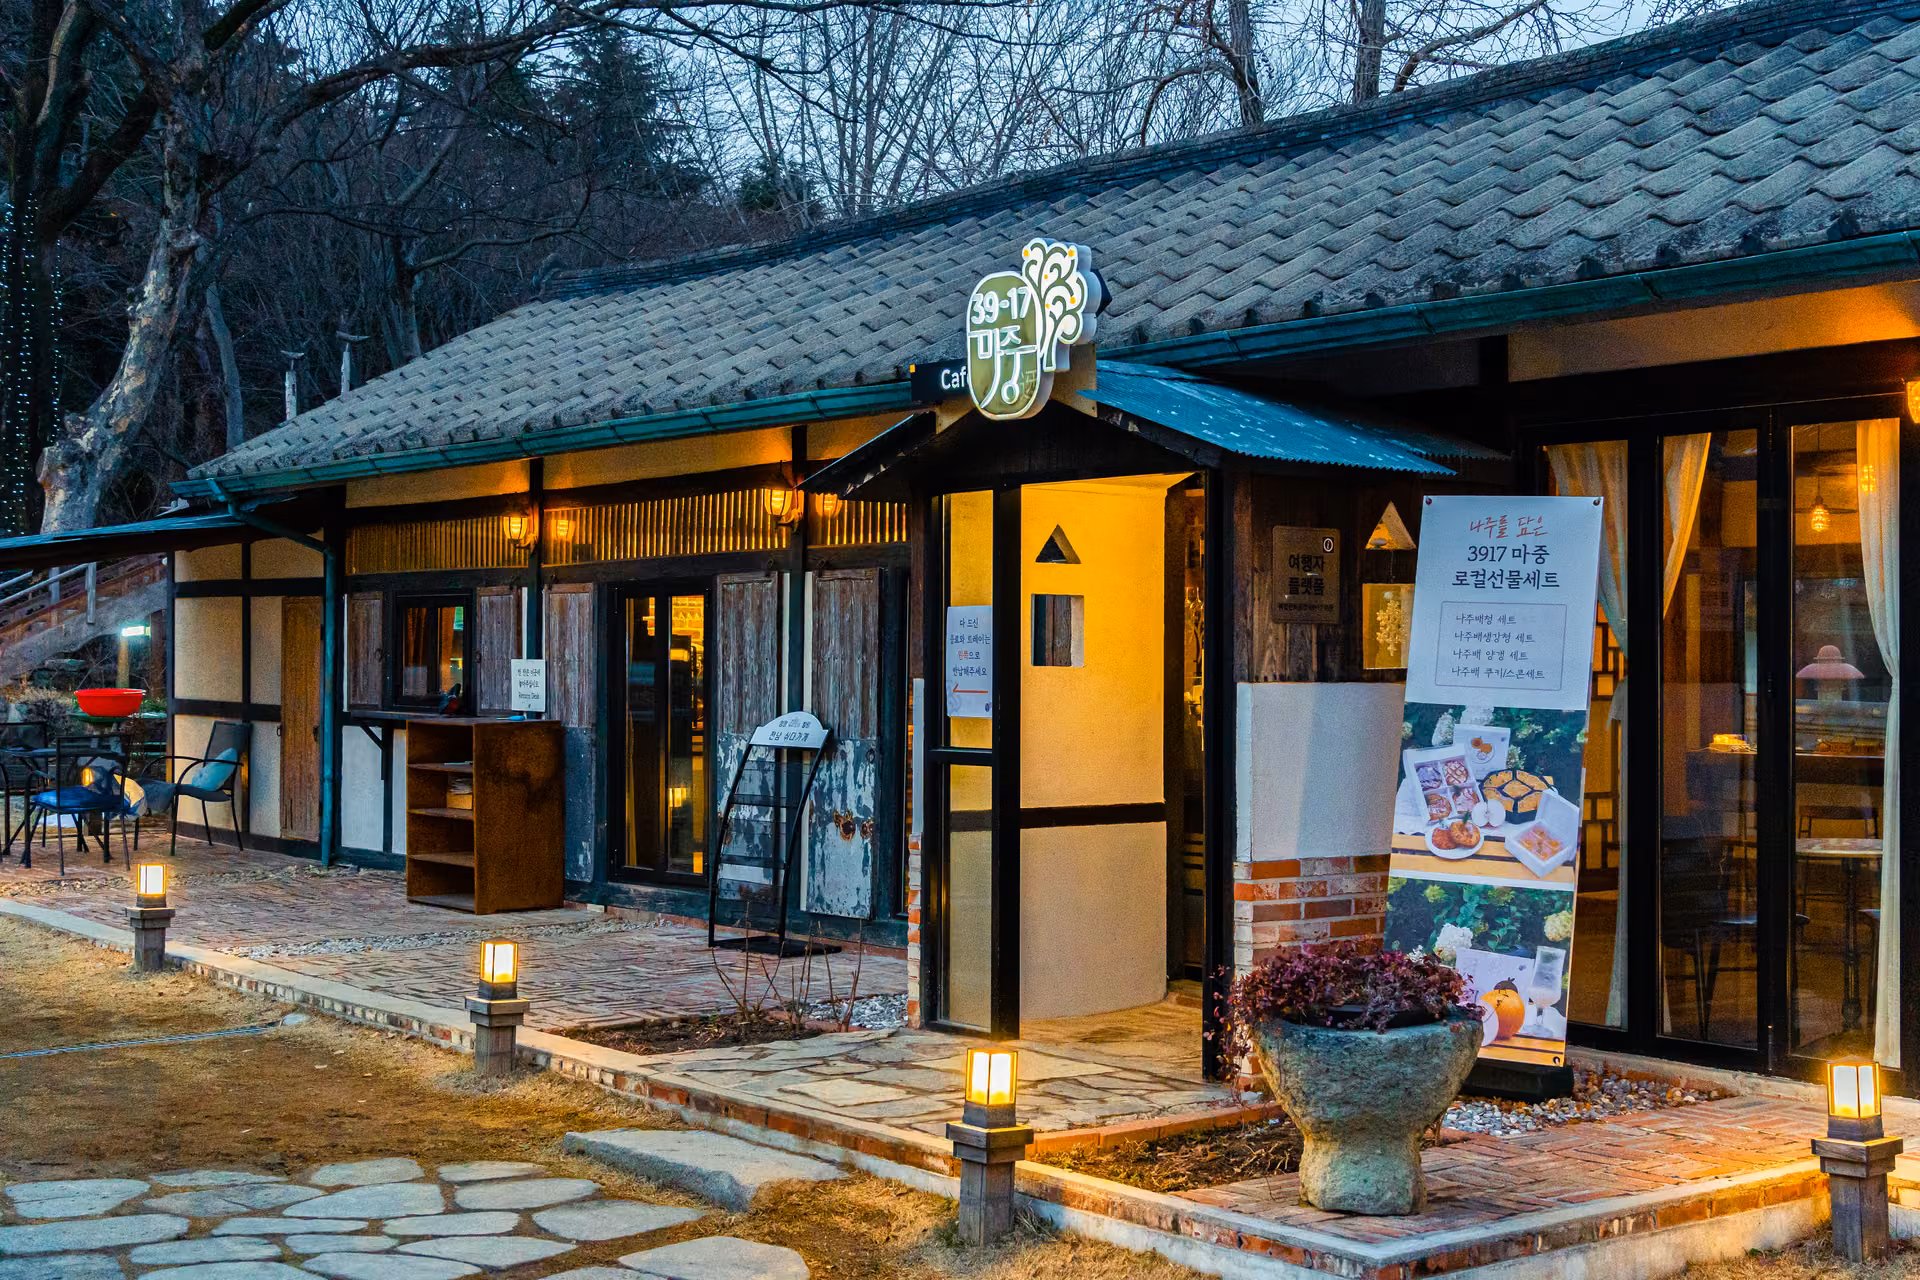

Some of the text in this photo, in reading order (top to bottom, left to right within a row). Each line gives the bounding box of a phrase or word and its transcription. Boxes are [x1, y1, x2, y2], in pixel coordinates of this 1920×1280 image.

[968, 325, 1038, 408] 마중
[1469, 515, 1509, 538] 나주를
[1288, 554, 1326, 573] 여행자
[1467, 544, 1550, 565] 3917 마중
[1288, 577, 1326, 596] 플랫폼
[1451, 569, 1560, 590] 로컬선물세트
[1456, 612, 1517, 625] 나주배청 세트
[1454, 631, 1535, 643] 나주배생강청 세트
[1453, 648, 1529, 661] 나주배 양갱 세트
[1451, 667, 1480, 678] 나주배
